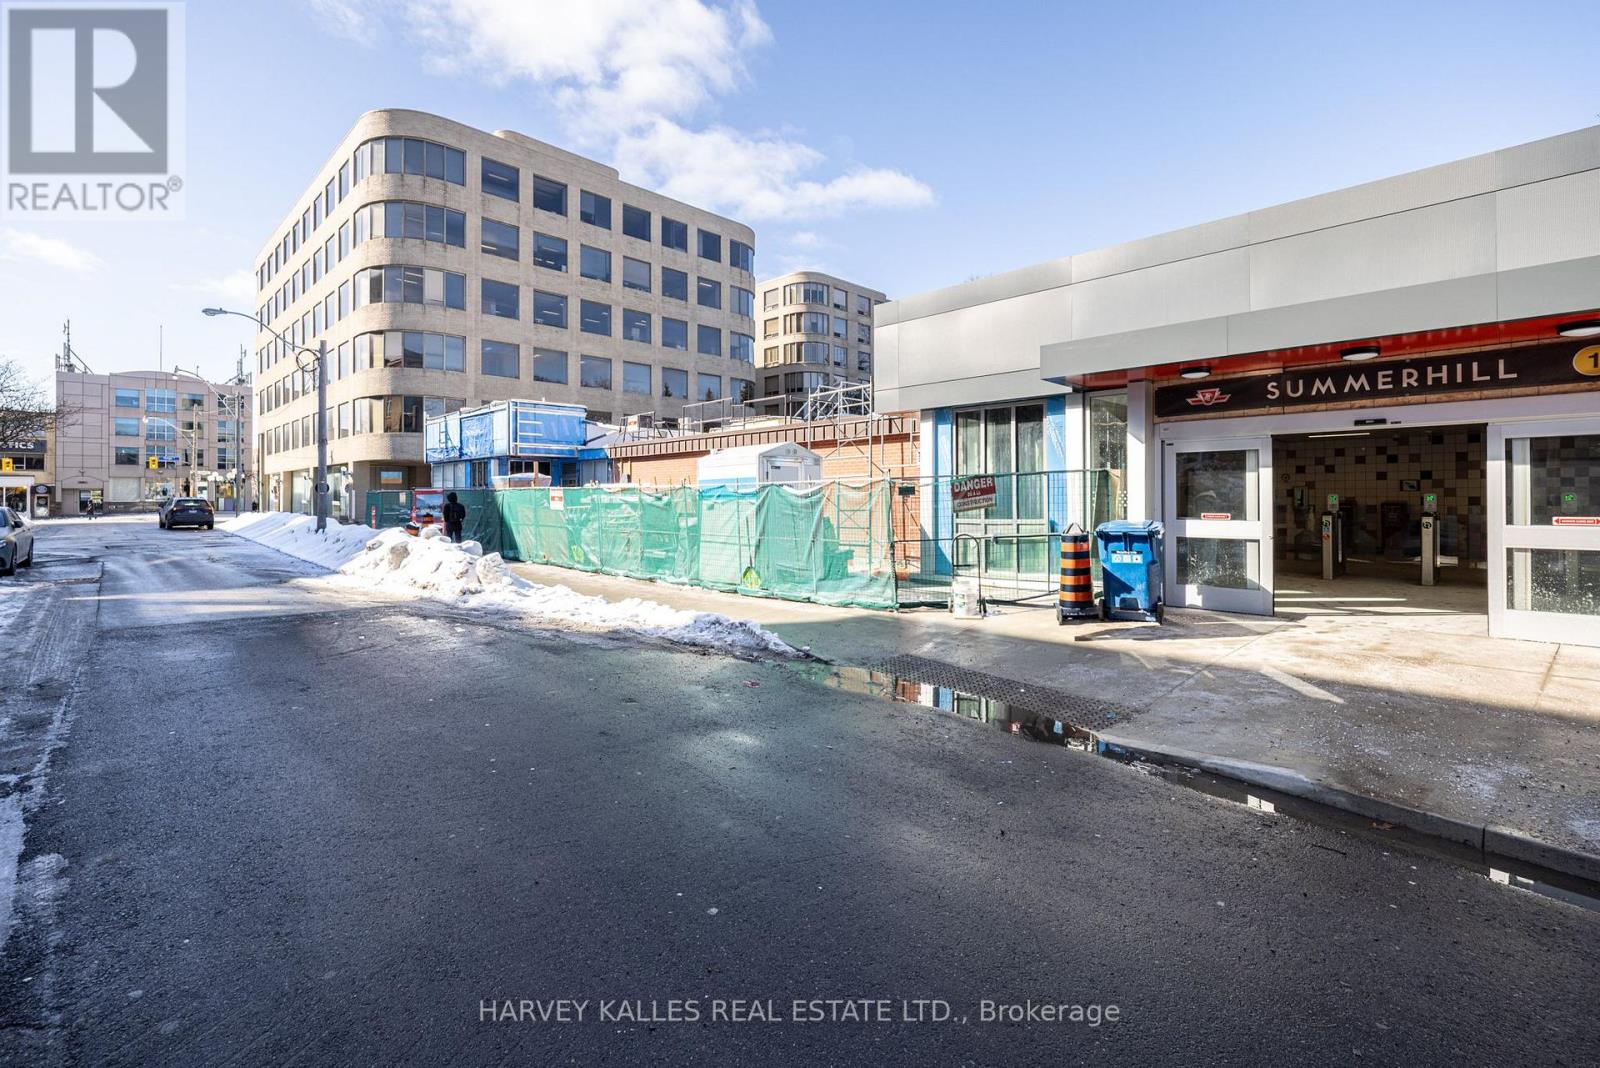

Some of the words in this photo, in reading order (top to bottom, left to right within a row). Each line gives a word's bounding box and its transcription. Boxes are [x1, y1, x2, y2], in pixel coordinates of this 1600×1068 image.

[1588, 352, 1599, 369] 1
[1266, 359, 1518, 399] SUMMERHILL
[954, 477, 993, 492] DANGER
